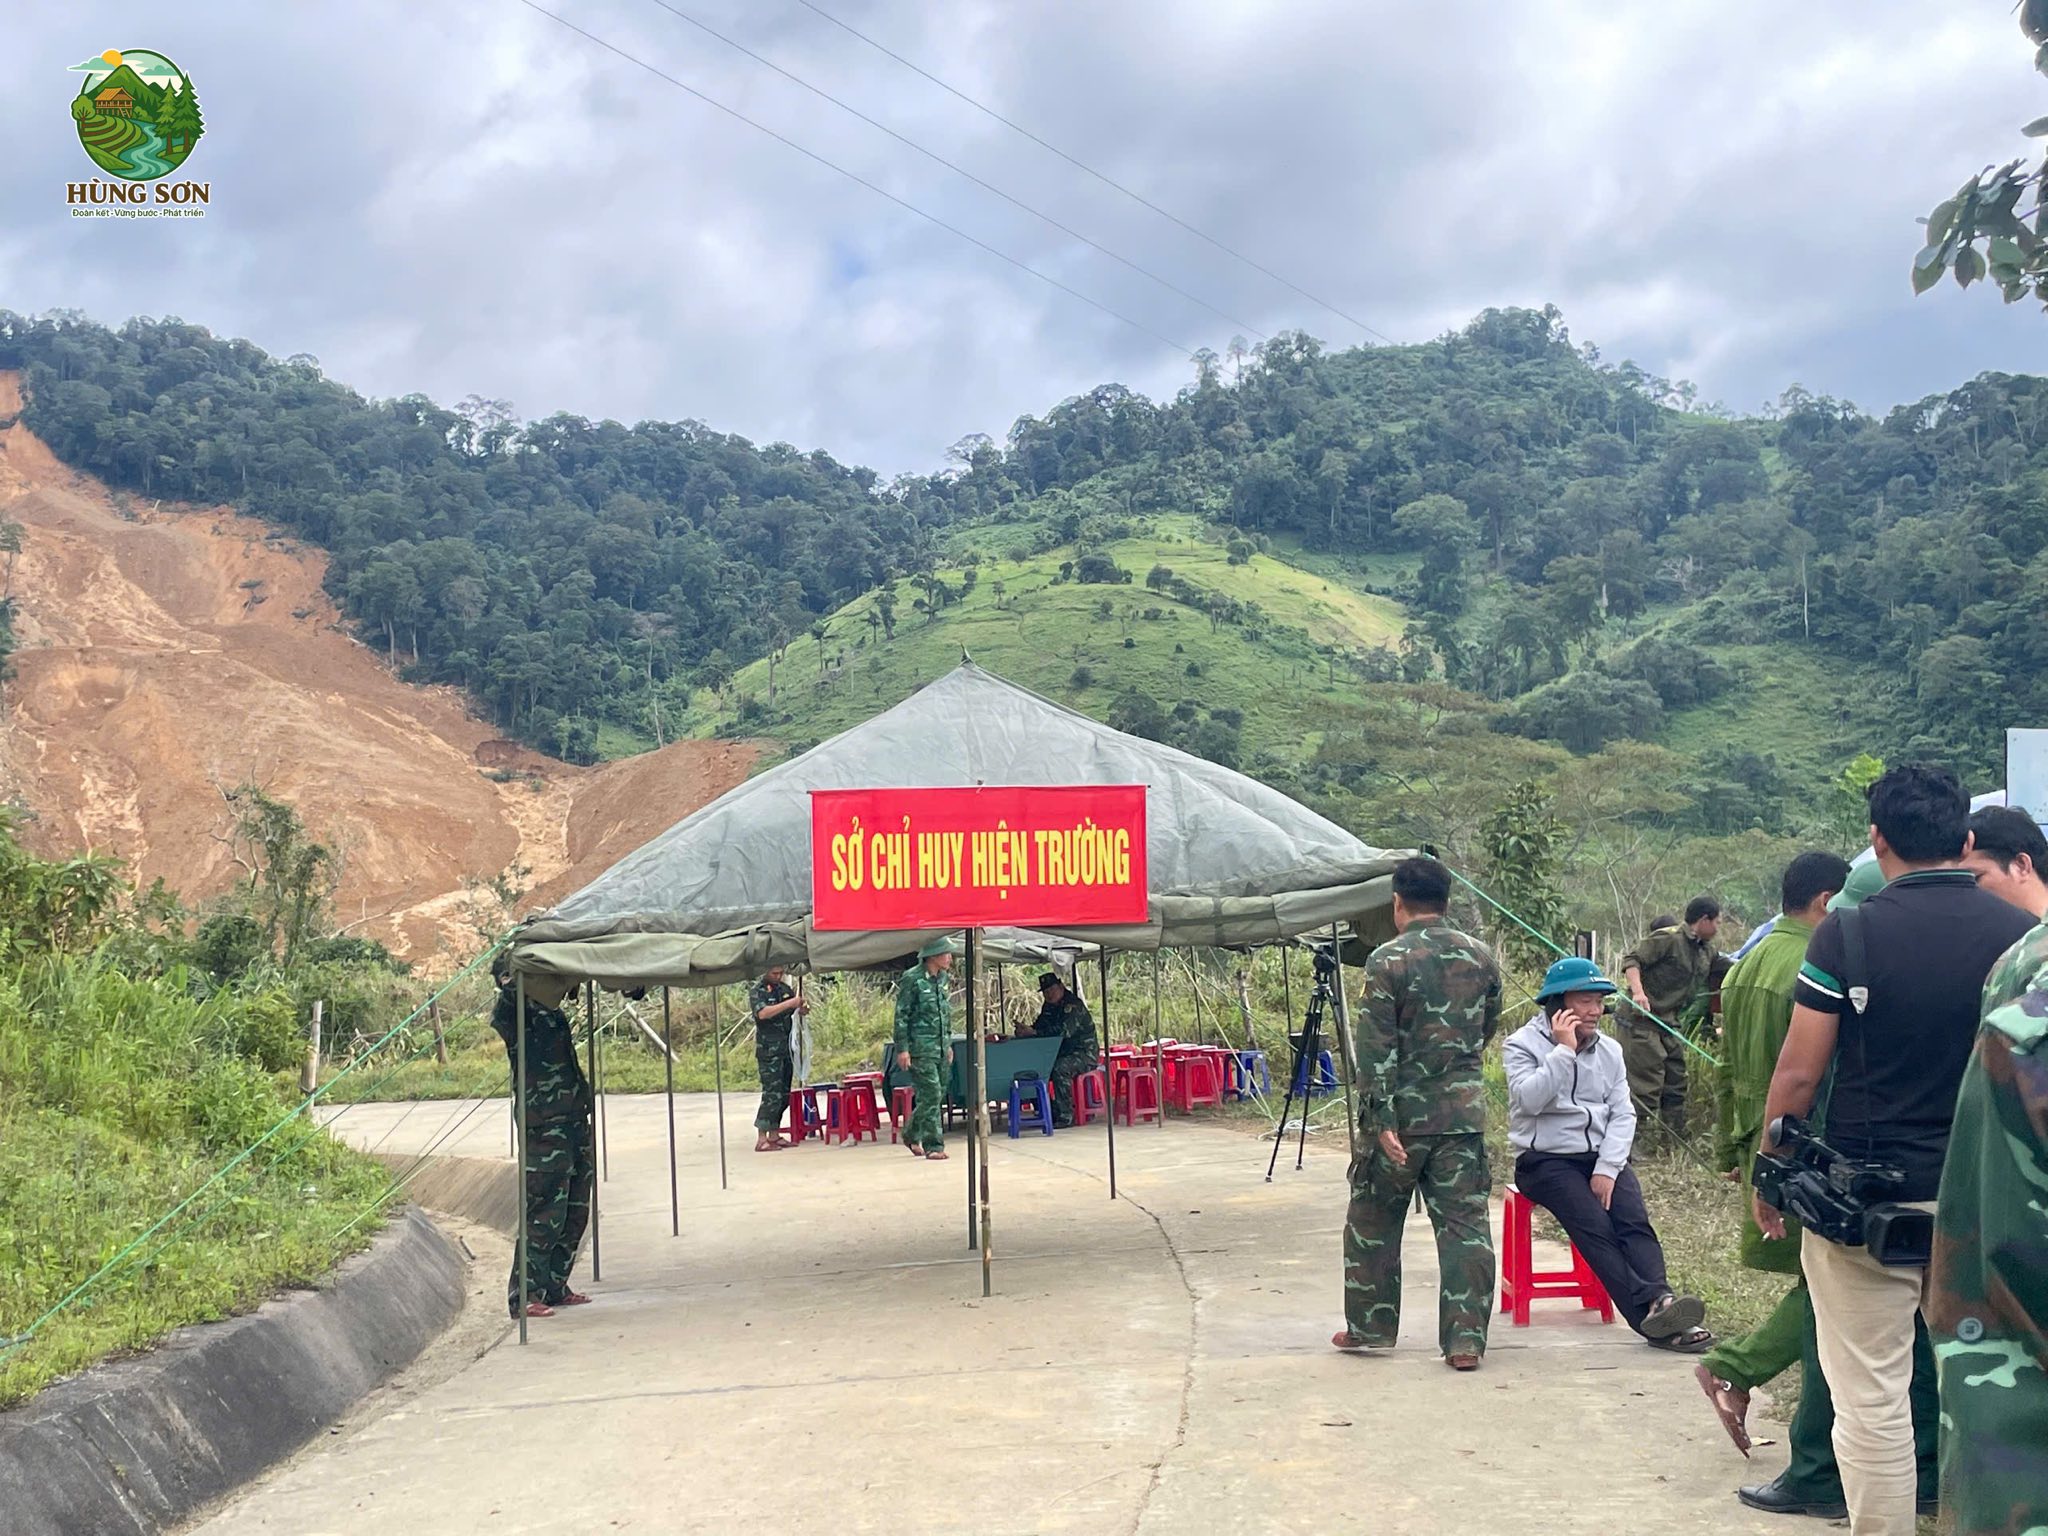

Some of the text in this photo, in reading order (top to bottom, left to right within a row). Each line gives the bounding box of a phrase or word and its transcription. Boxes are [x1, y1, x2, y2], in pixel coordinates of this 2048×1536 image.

[831, 815, 1130, 899] SỞ CHỈ HUY HIỆN TRƯỜNG
